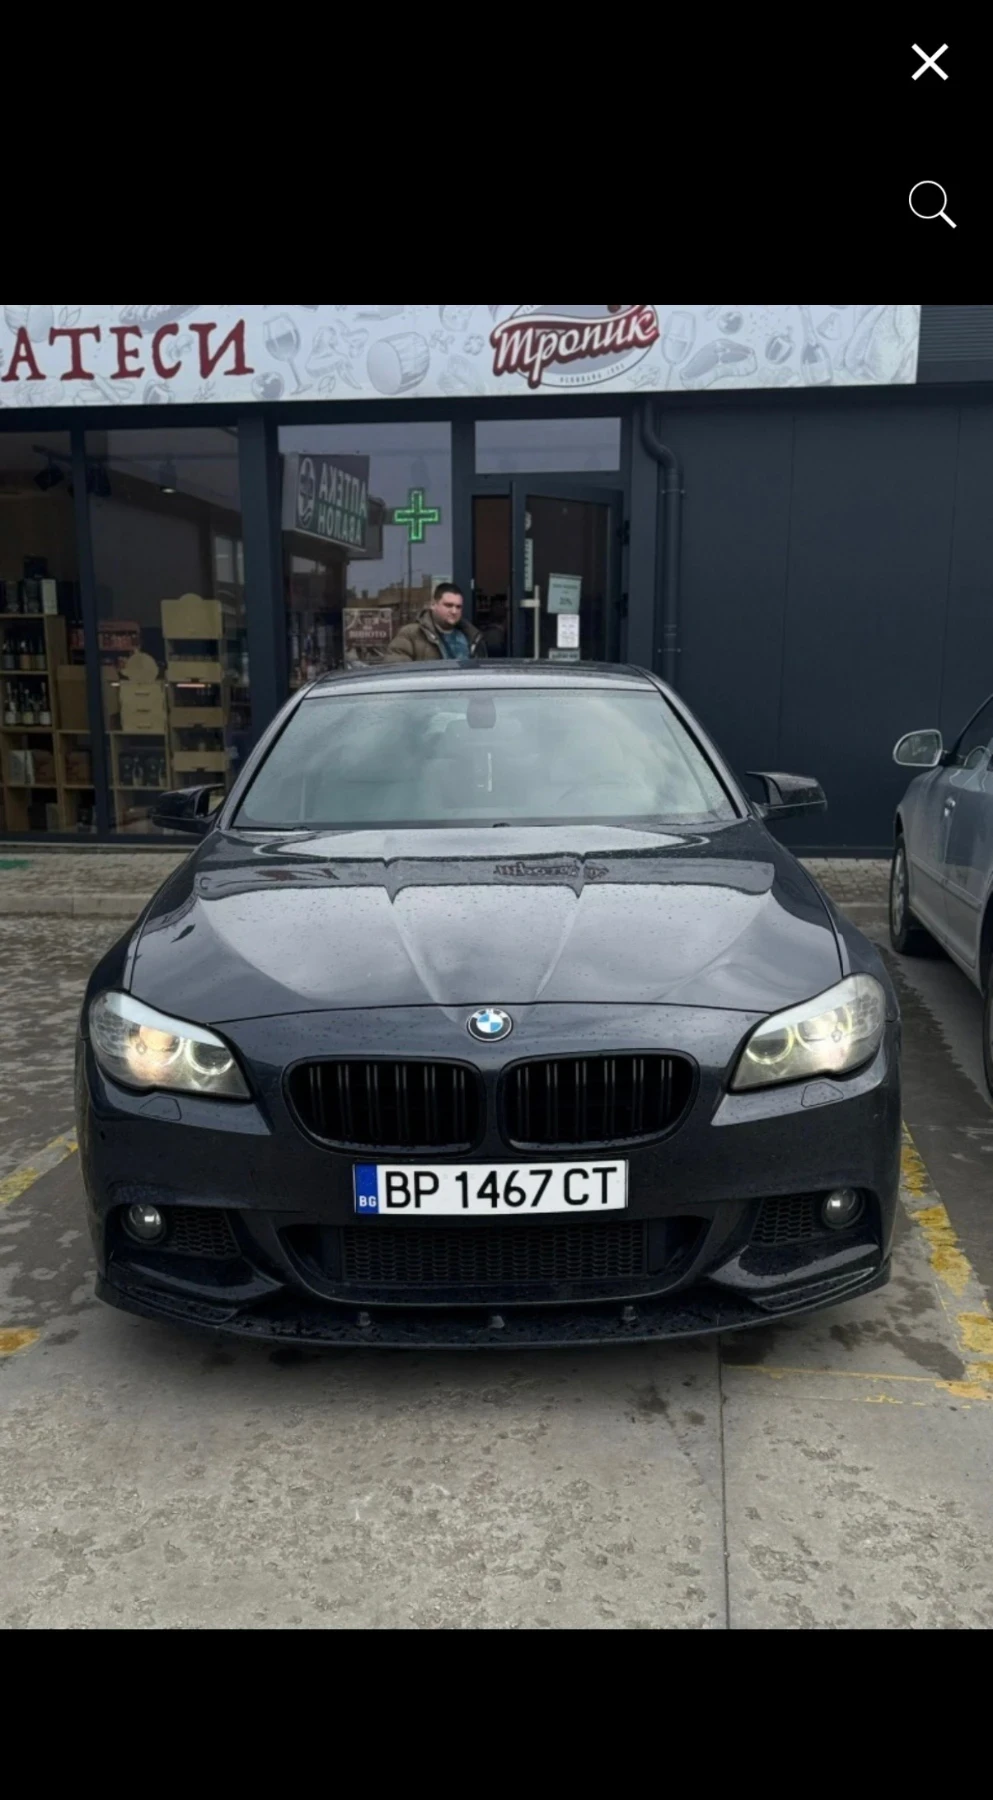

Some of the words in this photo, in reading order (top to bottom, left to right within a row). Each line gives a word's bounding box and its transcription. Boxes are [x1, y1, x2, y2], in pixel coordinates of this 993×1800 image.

[1, 318, 255, 382] АТЕСИ
[359, 1195, 377, 1208] BG
[385, 1170, 440, 1209] BP
[455, 1168, 553, 1209] 1467
[563, 1166, 618, 1206] CT
